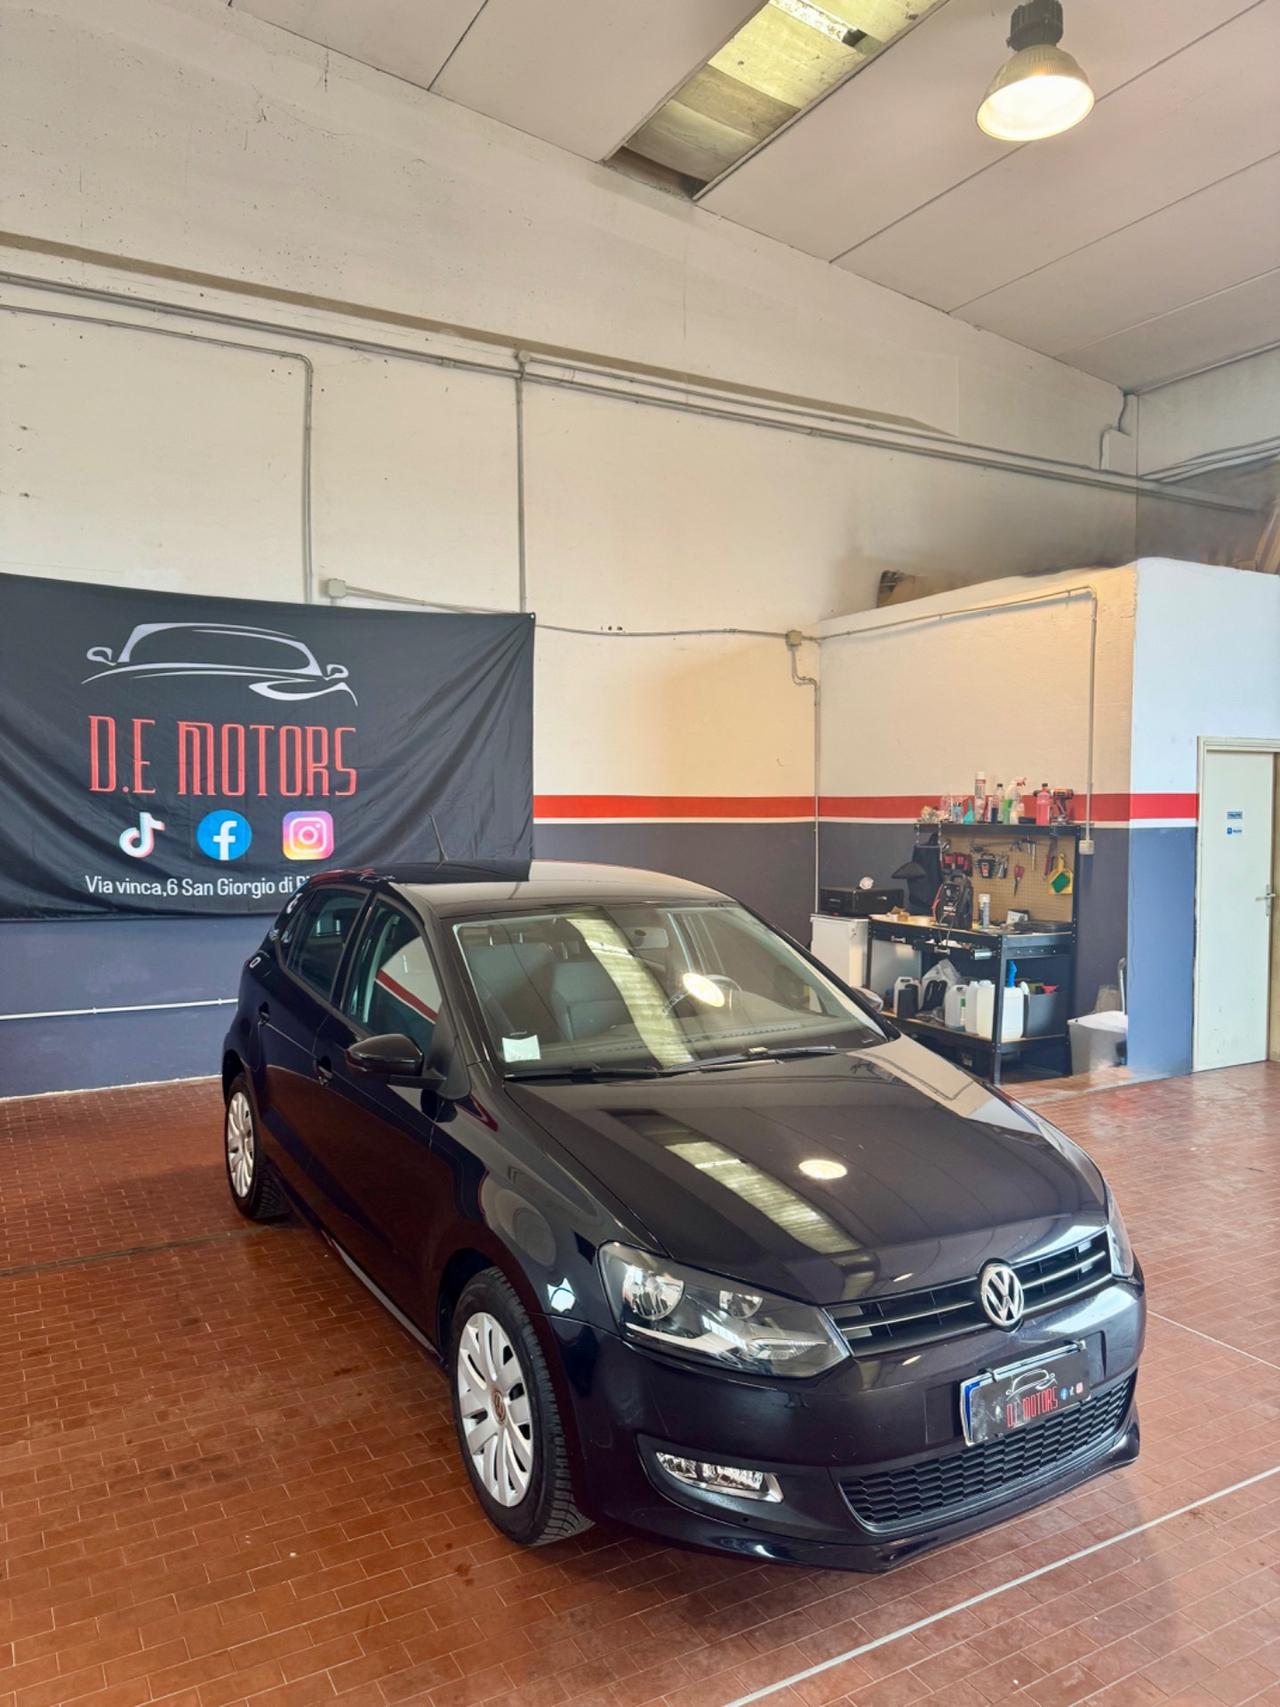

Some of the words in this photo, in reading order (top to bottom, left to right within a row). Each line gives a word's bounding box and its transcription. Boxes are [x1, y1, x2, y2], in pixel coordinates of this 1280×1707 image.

[88, 715, 157, 793] D.E
[177, 720, 358, 796] MOTORS
[85, 875, 113, 894] Via
[115, 878, 178, 897] vinca,6
[182, 879, 213, 896] San
[217, 876, 274, 899] Giorgio
[279, 875, 293, 894] di
[1022, 1386, 1058, 1422] MOTORS
